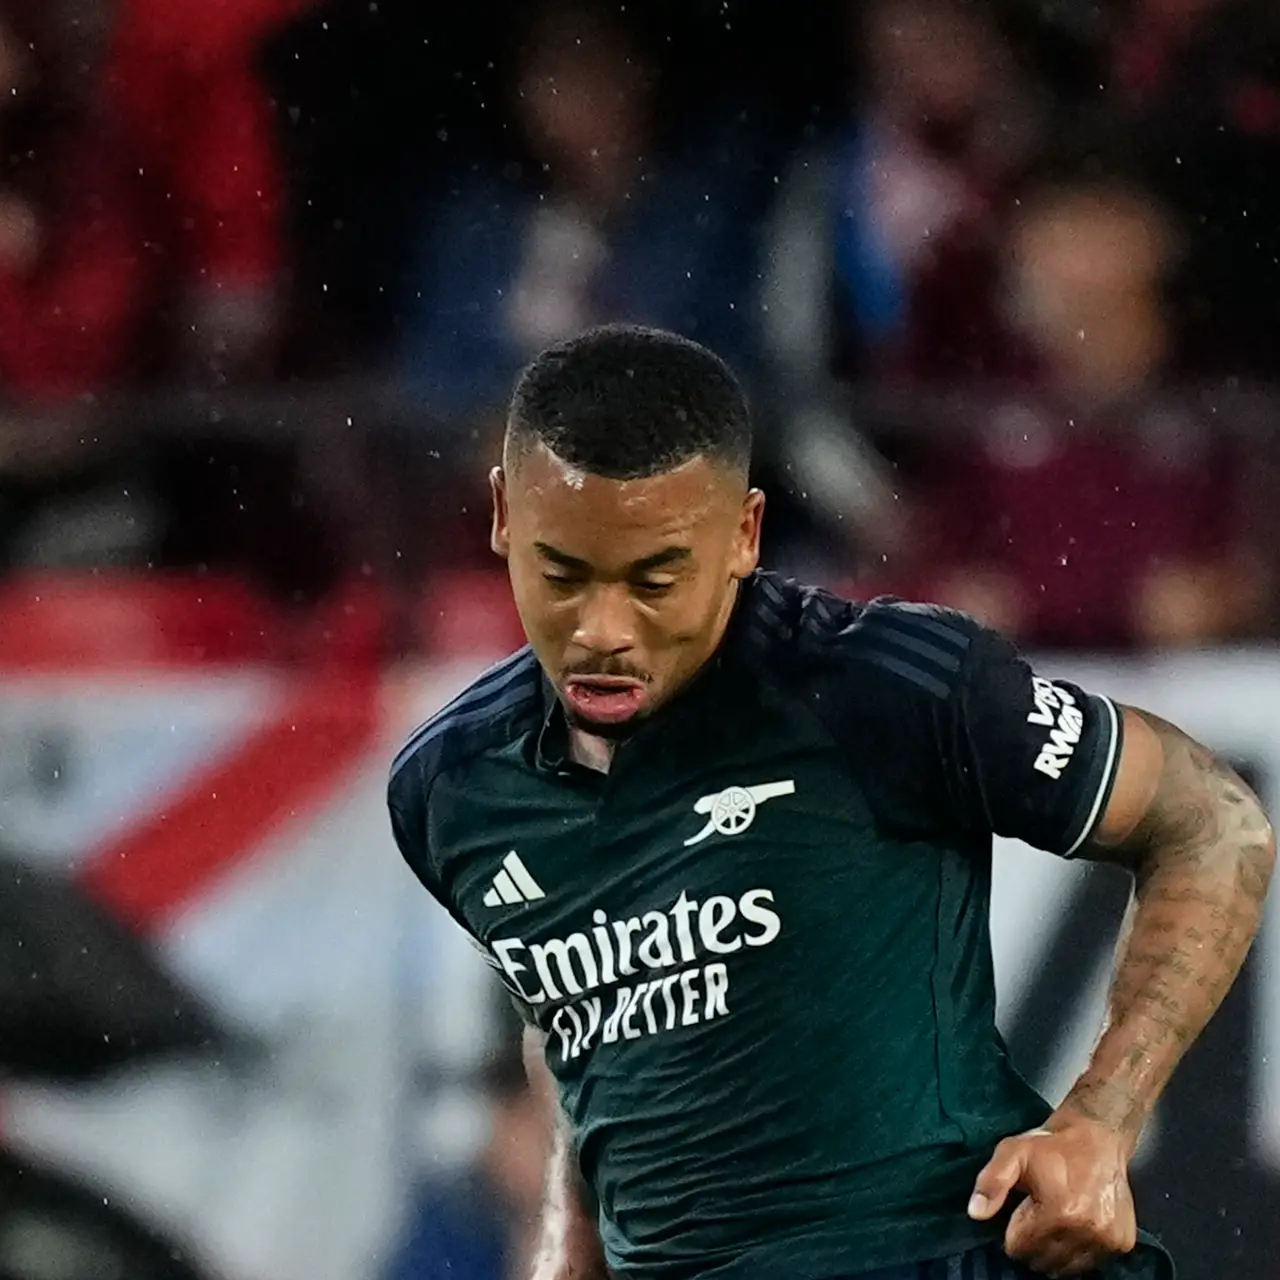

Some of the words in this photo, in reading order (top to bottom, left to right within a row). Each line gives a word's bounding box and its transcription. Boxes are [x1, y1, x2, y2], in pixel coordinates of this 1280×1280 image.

[492, 889, 781, 1004] Emirates
[552, 997, 602, 1062] FLY
[603, 963, 730, 1044] BETTER
